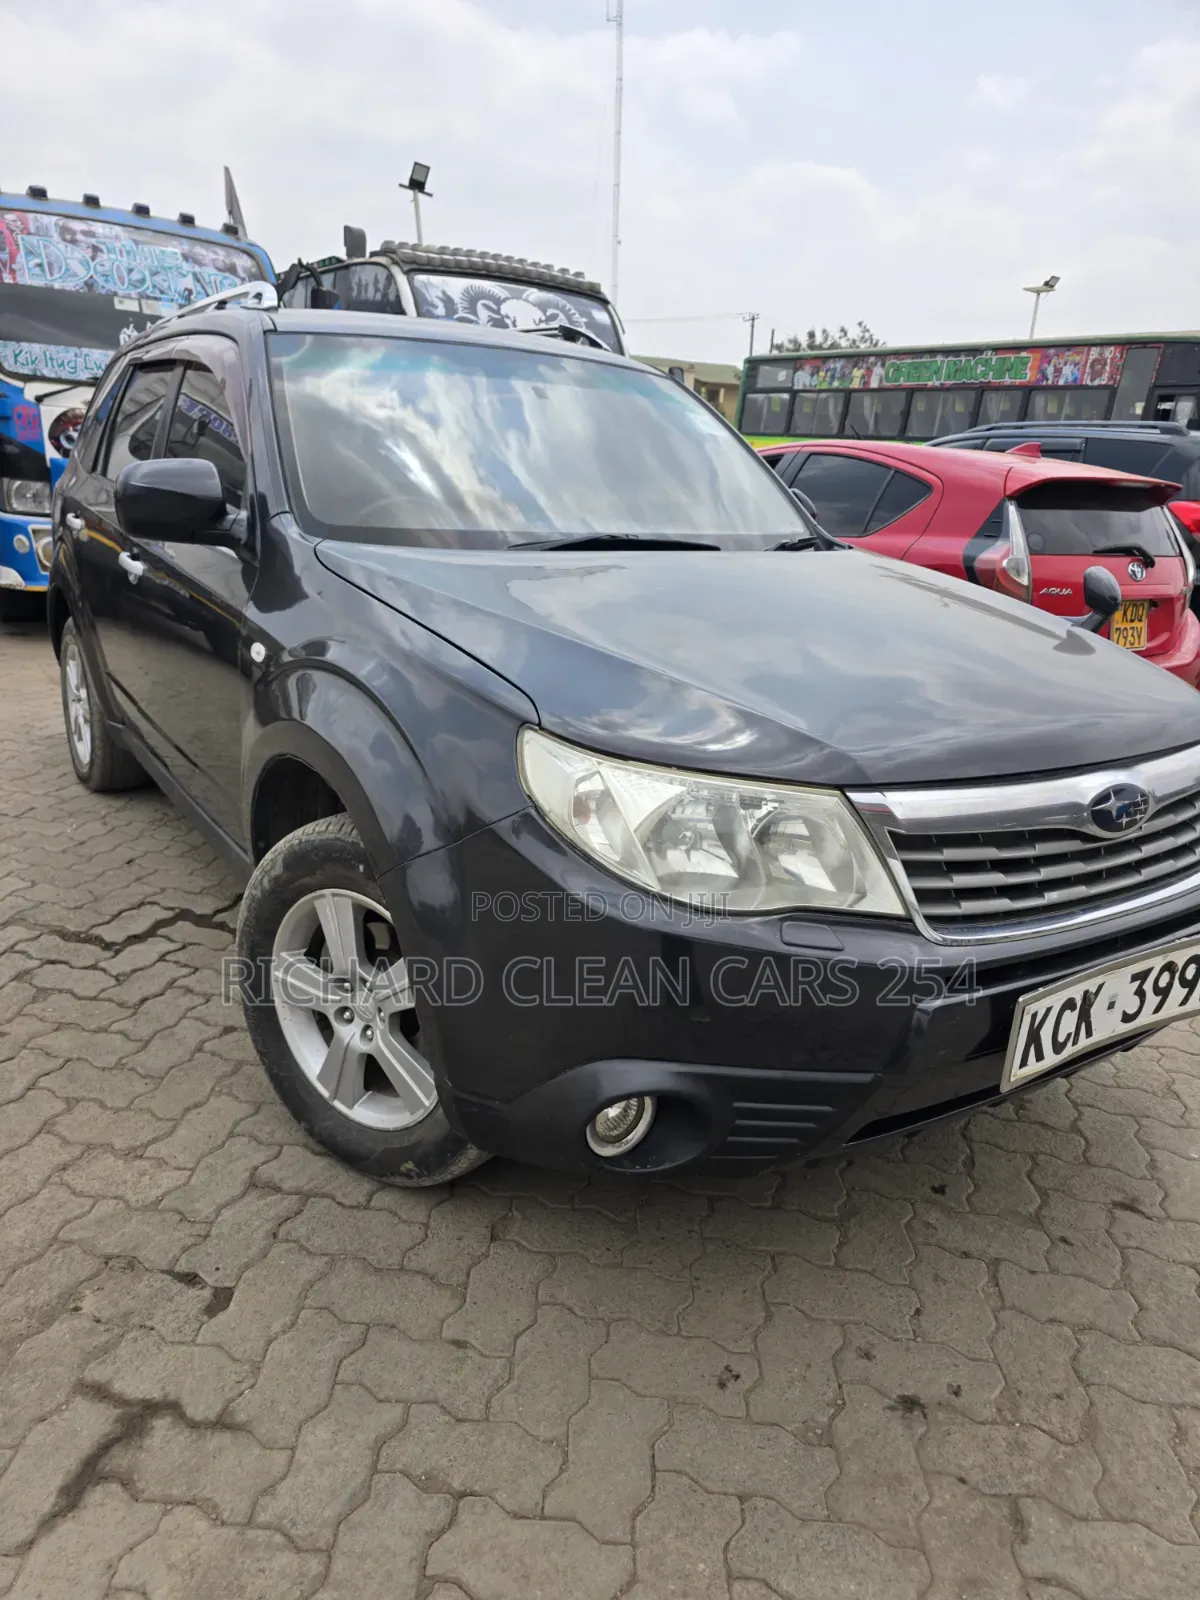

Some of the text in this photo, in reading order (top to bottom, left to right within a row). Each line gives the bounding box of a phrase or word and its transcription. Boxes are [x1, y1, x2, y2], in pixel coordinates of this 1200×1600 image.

[884, 355, 1031, 385] GREEN MACHINE
[1040, 587, 1073, 595] AQUA
[1115, 626, 1143, 646] 793Y
[1019, 953, 1200, 1070] KCK 399
